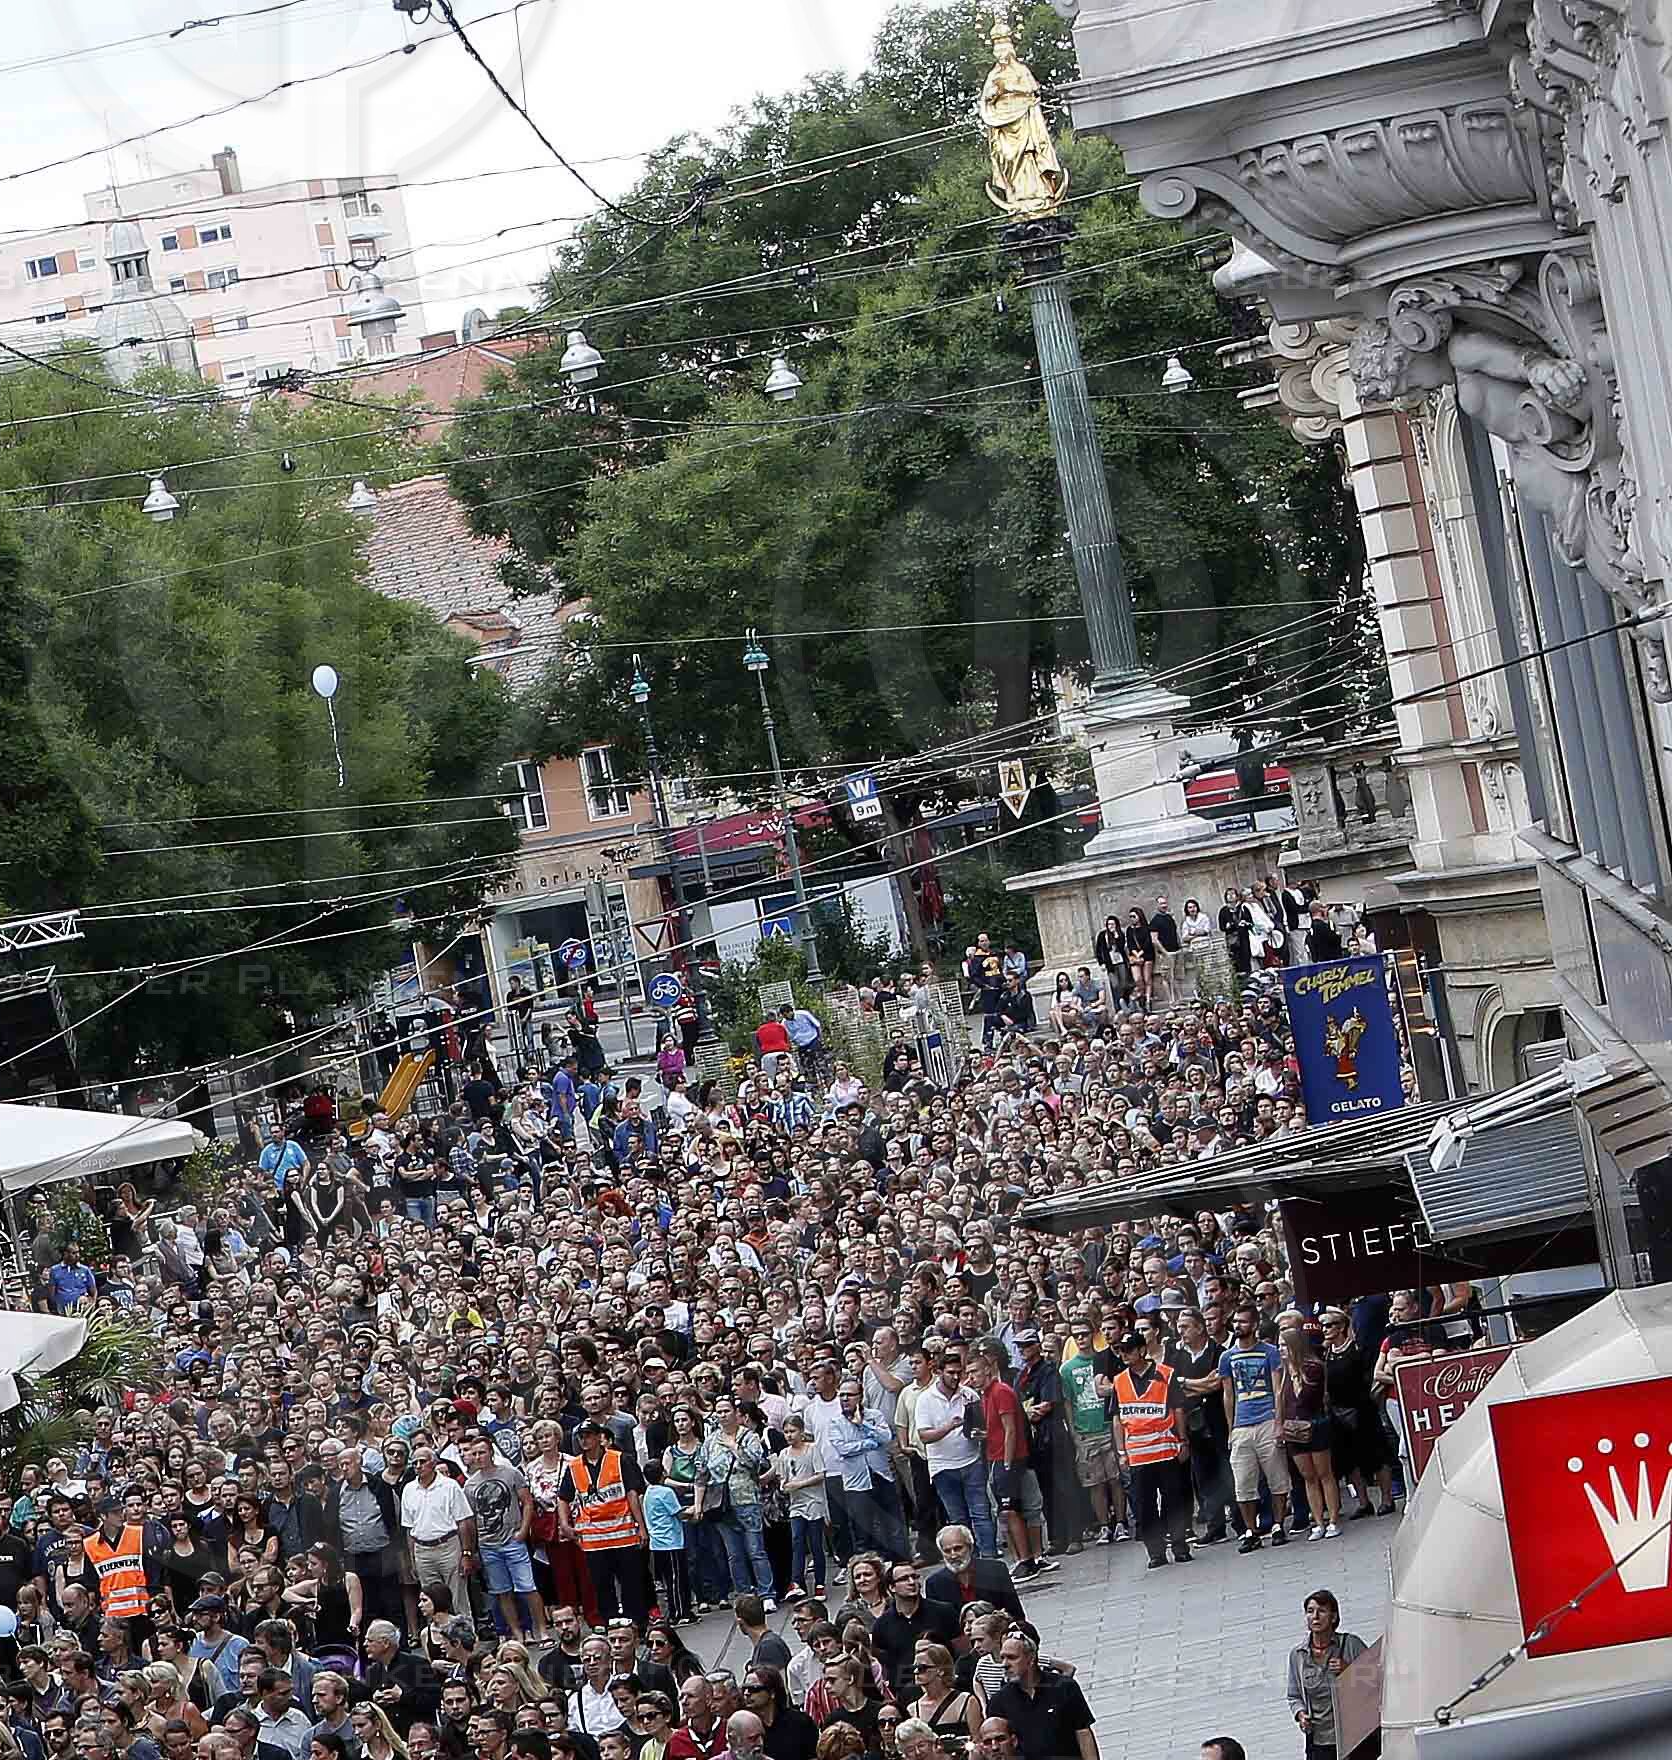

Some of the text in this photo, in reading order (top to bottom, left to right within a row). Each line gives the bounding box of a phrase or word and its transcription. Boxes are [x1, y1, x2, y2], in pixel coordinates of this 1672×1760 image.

[847, 777, 870, 797] W
[1294, 966, 1350, 995] CHARLY
[1320, 969, 1375, 1004] TEMMEL
[1330, 1097, 1382, 1113] GELATO
